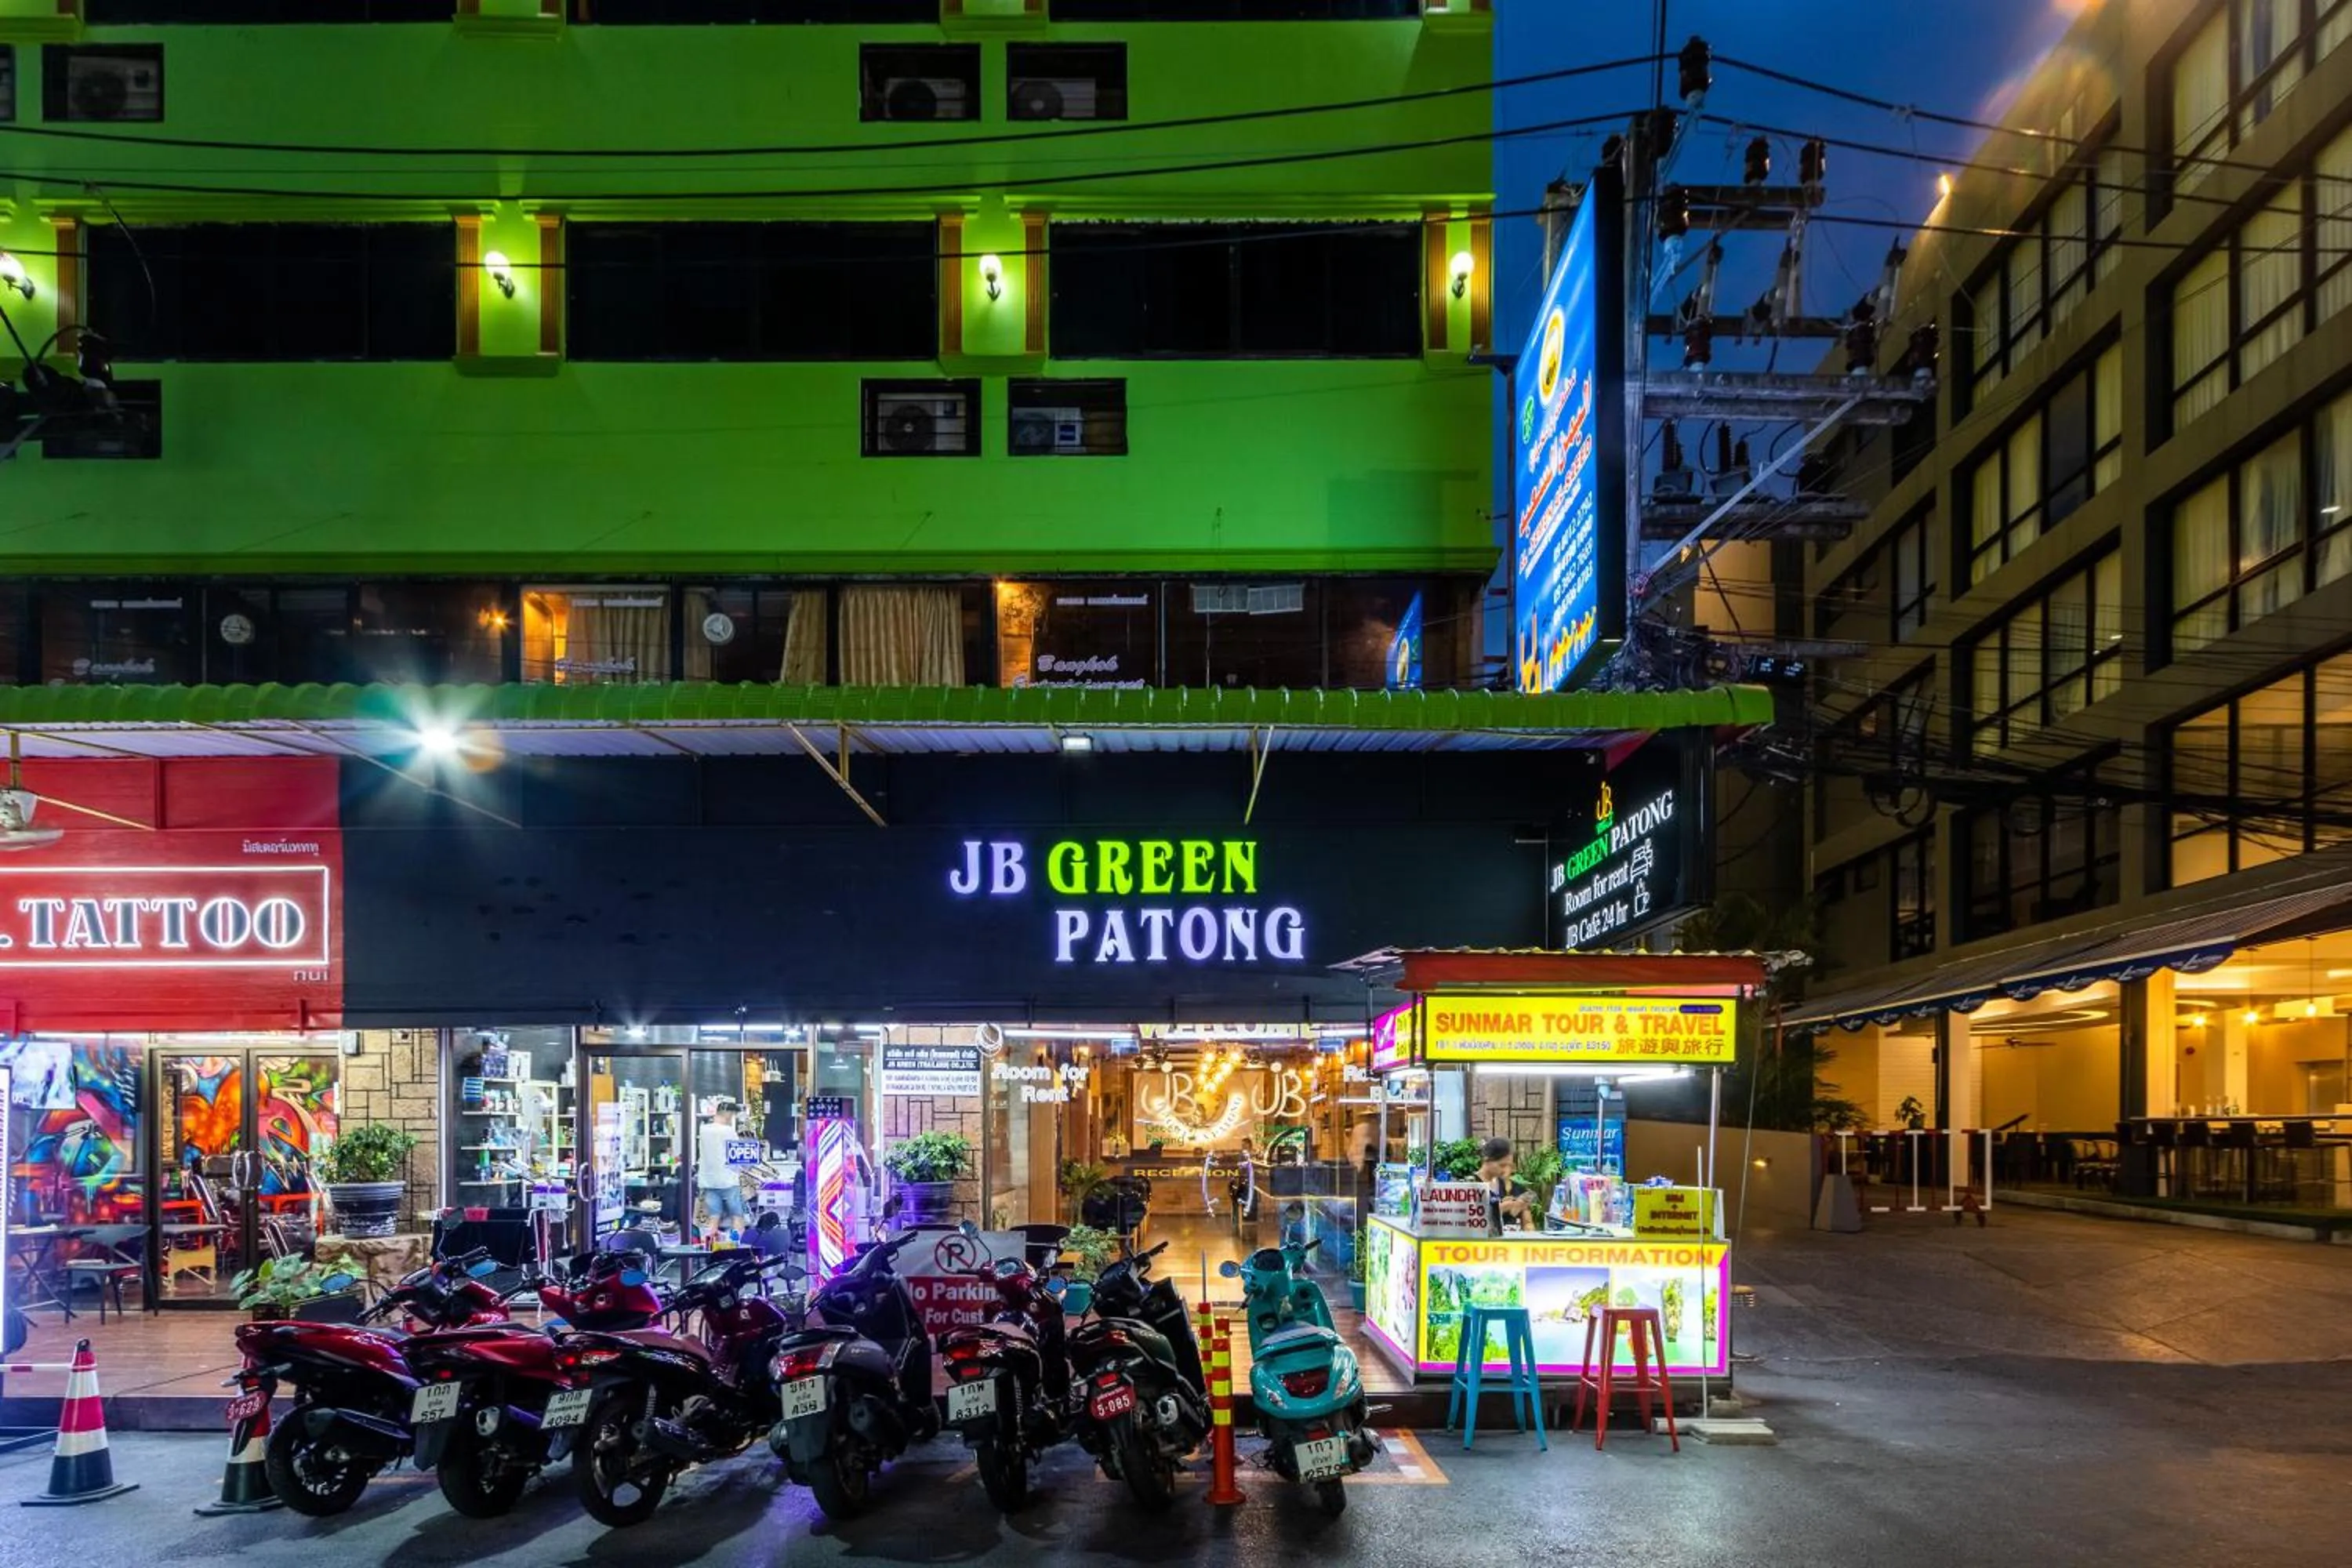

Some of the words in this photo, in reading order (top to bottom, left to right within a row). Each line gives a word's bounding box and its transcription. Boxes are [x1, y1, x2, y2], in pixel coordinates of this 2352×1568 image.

[1551, 863, 1565, 892] JB
[1567, 833, 1608, 880] GREEN
[1611, 790, 1673, 853] PATONG
[949, 840, 1026, 894] JB
[1048, 840, 1258, 894] GREEN
[1565, 887, 1592, 916] Room
[1593, 874, 1607, 901] for
[1608, 862, 1628, 891] rent
[19, 896, 304, 948] TATTOO
[1566, 924, 1578, 949] JB
[1602, 904, 1614, 933] 24
[1616, 900, 1628, 927] hr
[1055, 907, 1305, 962] PATONG
[1436, 1012, 1532, 1034] SUNMAR
[1541, 1013, 1604, 1034] TOUR
[1614, 1014, 1629, 1034] &
[1646, 1014, 1726, 1035] TRAVEL
[991, 1062, 1051, 1080] Room
[1059, 1062, 1089, 1081] for
[1020, 1084, 1069, 1103] Rent
[728, 1147, 758, 1160] OPEN
[1420, 1188, 1486, 1203] LAUNDRY
[1468, 1203, 1485, 1216] 50
[1468, 1218, 1487, 1229] 100
[1434, 1246, 1508, 1262] TOUR
[1523, 1247, 1713, 1265] INFORMATION
[909, 1282, 927, 1301] o
[932, 1282, 1000, 1301] Parkin
[926, 1308, 949, 1323] For
